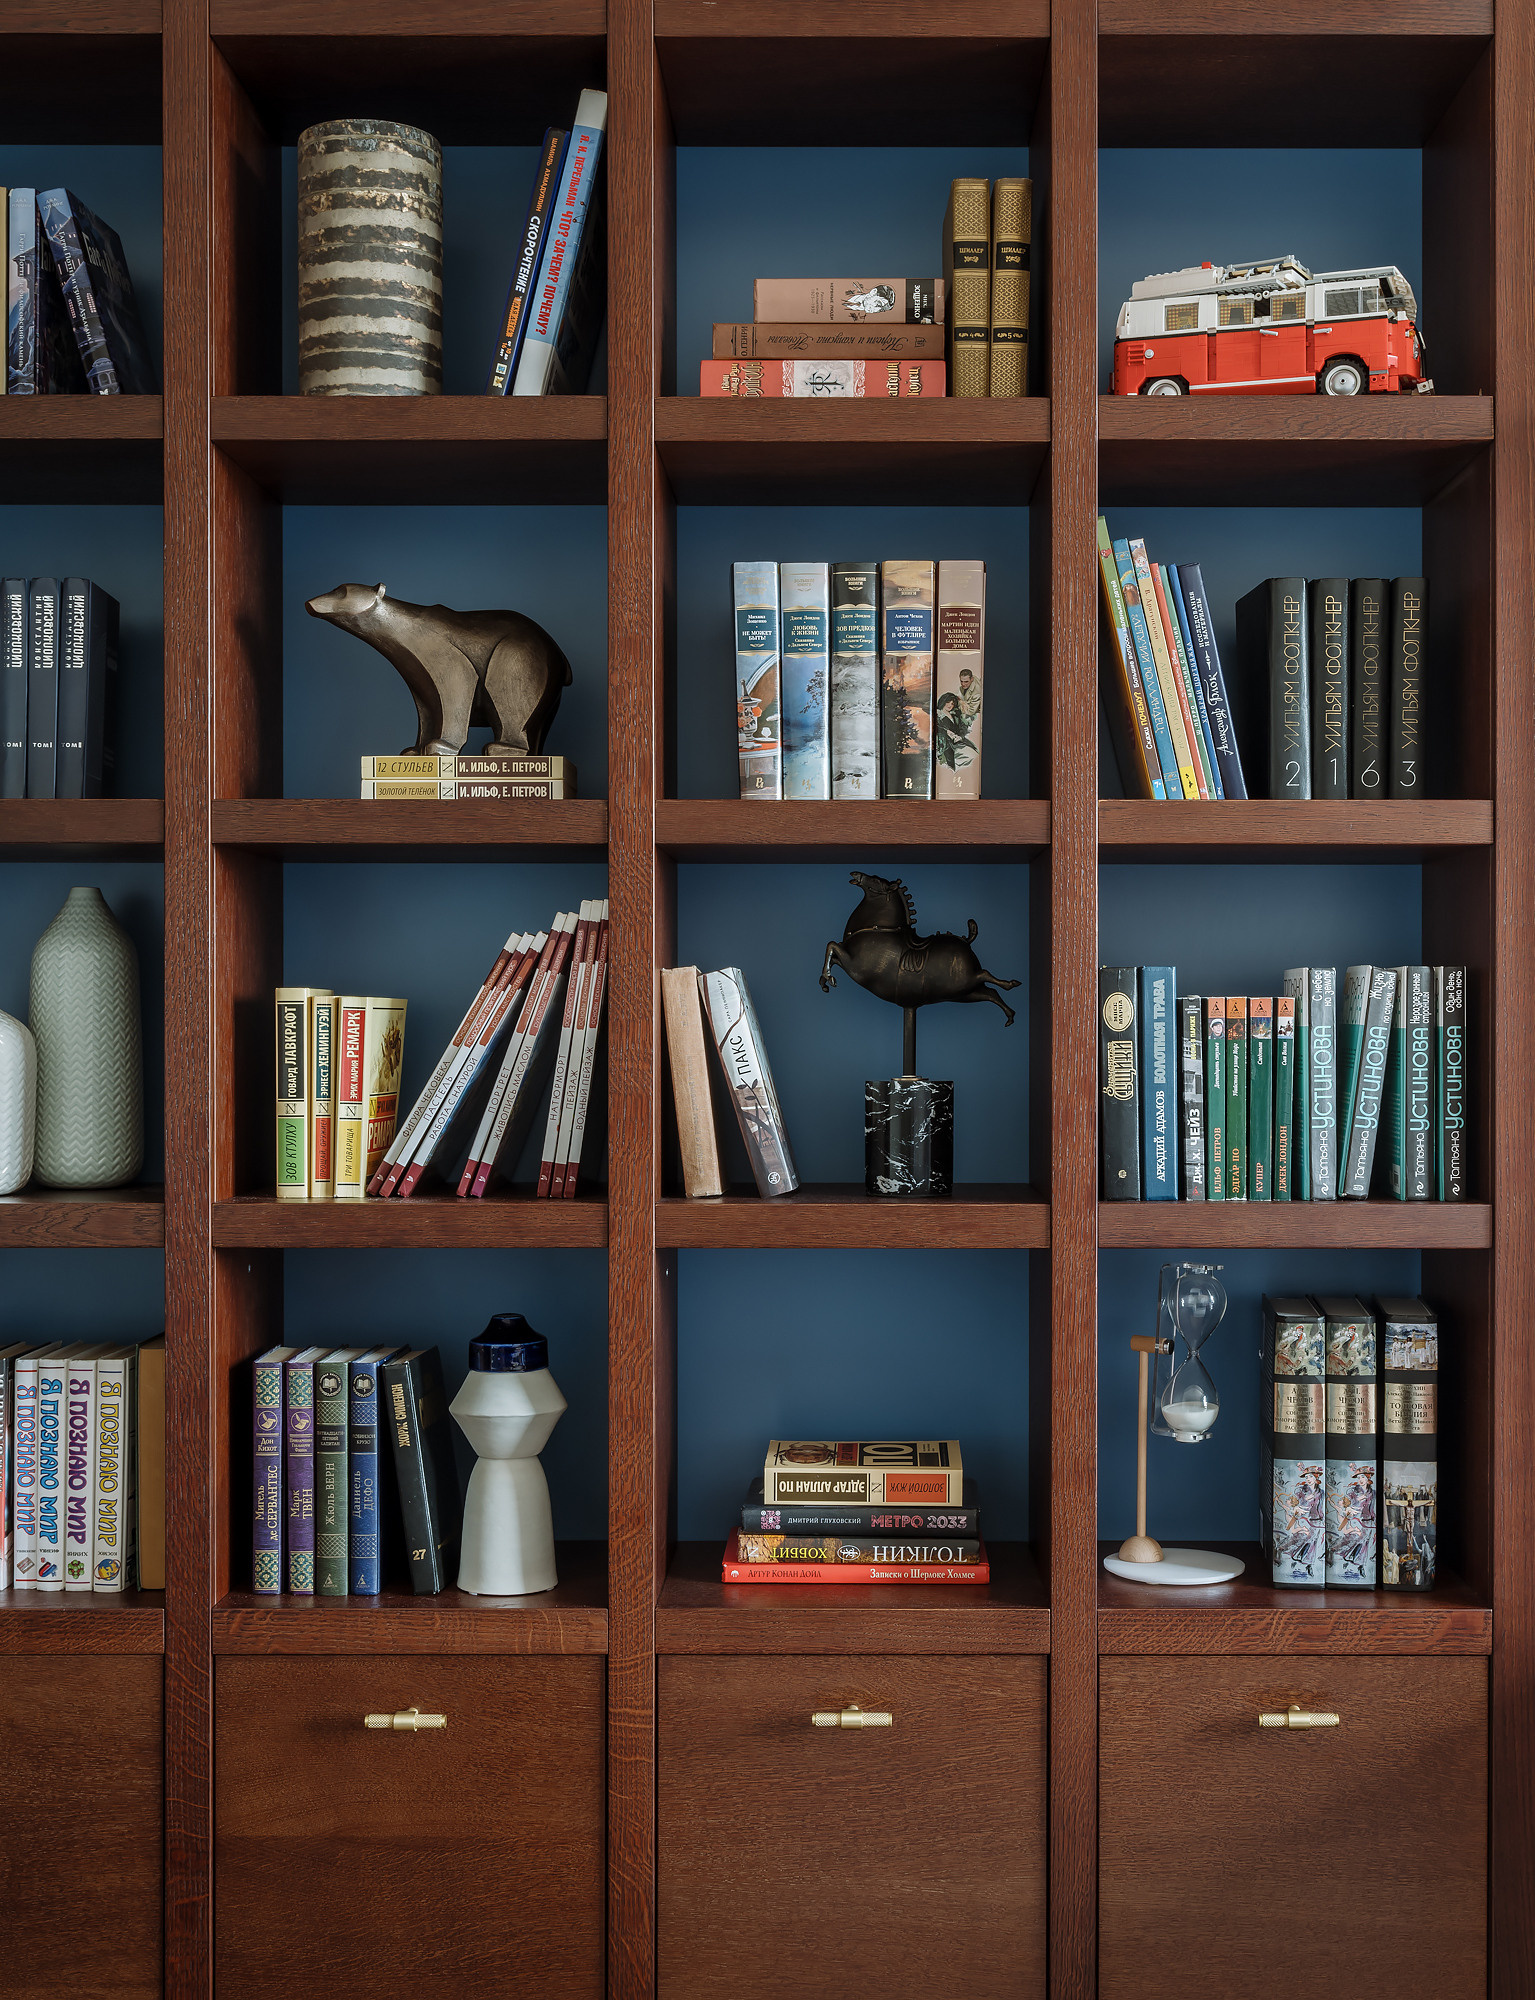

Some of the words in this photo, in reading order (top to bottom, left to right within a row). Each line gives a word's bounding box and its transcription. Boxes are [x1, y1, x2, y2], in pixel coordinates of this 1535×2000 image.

[546, 137, 558, 166] ШАМИЛЬ
[577, 145, 588, 155] И.
[580, 134, 590, 143] Я.
[535, 167, 551, 212] АХМАДУЛЛИН
[565, 156, 585, 206] ПЕРЕЛЬМАН
[560, 211, 574, 237] ЧТО?
[515, 215, 540, 293] СКОРОЧТЕНИЕ
[549, 237, 567, 283] ЗАЧЕМ?
[535, 285, 556, 336] ПОЧЕМУ?
[43, 595, 54, 669] ЦИОЛКОВСКИЙ
[73, 595, 85, 669] ЦИОЛКОВСКИЙ
[1188, 591, 1205, 648] ИССЛЕДОВАНИЯ
[1284, 595, 1300, 675] ФОЛКНЕР
[1325, 595, 1342, 675] ФОЛКНЕР
[1362, 596, 1380, 676] ФОЛКНЕР
[1402, 591, 1421, 672] ФОЛКНЕР
[1186, 641, 1202, 690] ПОРТНЯЖКА
[1195, 690, 1208, 724] ХРАБРЫЙ
[1204, 672, 1223, 706] Блок
[1284, 681, 1300, 752] УИЛЬЯМ
[1325, 681, 1342, 753] УИЛЬЯМ
[1362, 682, 1379, 753] УИЛЬЯМ
[1401, 678, 1419, 749] УИЛЬЯМ
[1216, 708, 1234, 756] Александр
[377, 762, 386, 772] 12
[391, 762, 434, 773] СТУЛЬЕВ
[459, 762, 469, 772] И.
[470, 761, 501, 774] ИЛЬФ,
[502, 762, 511, 772] Е.
[512, 762, 548, 773] ПЕТРОВ
[1285, 761, 1300, 787] 2
[1330, 758, 1337, 786] 1
[1361, 760, 1380, 788] 6
[1399, 760, 1417, 787] 3
[378, 787, 406, 796] ЗОЛОТОЙ
[408, 786, 436, 796] ТЕЛЁНОК
[459, 786, 470, 798] И.
[471, 786, 501, 799] ИЛЬФ,
[502, 786, 511, 798] Е.
[512, 786, 547, 798] ПЕТРОВ
[1410, 972, 1421, 1024] Неразрезанные
[1446, 971, 1456, 992] день,
[1153, 978, 1166, 1024] ТРАВА
[1445, 993, 1455, 1013] Один
[284, 1006, 298, 1066] ЛАВКРАФТ
[317, 1008, 330, 1065] ХЕМИНГУЭЙ
[346, 1012, 361, 1058] РЕМАРК
[351, 1060, 359, 1082] МАРИЯ
[581, 1046, 594, 1087] ПЕЙЗАЖ
[729, 1035, 752, 1076] ПАКС
[1153, 1026, 1166, 1084] БОЛОТНАЯ
[287, 1067, 298, 1098] ГОВАРД
[321, 1066, 329, 1097] ЭРНЕСТ
[350, 1083, 358, 1100] ЭРИХ
[487, 1067, 511, 1114] ПОРТРЕТ
[492, 1089, 516, 1141] ЖИВОПИСЬ
[511, 1046, 533, 1090] МАСЛОМ
[549, 1054, 567, 1121] НАТЮРМОРТ
[565, 1069, 579, 1110] ПЕЙЗАЖ
[1311, 1025, 1336, 1130] УСТИНОВА
[1354, 1026, 1388, 1130] УСТИНОВА
[1410, 1027, 1430, 1131] УСТИНОВА
[1445, 1025, 1465, 1129] УСТИНОВА
[402, 1101, 424, 1139] ФИГУРА
[419, 1060, 451, 1103] ЧЕЛОВЕКА
[423, 1076, 453, 1122] ПАСТЕЛЬ
[575, 1087, 589, 1131] ВОДНЫЙ
[1155, 1090, 1165, 1135] АДАМОВ
[286, 1122, 297, 1157] КТУЛХУ
[345, 1128, 354, 1162] ТОВАРИЩА
[368, 1120, 396, 1150] РЕМАРК
[1186, 1108, 1201, 1147] ЧЕЙЗ
[1213, 1127, 1222, 1163] ПЕТРОВ
[1279, 1125, 1288, 1162] ЛОНДОН
[286, 1159, 297, 1180] ЗОВ
[344, 1164, 353, 1177] ТРИ
[1156, 1137, 1166, 1183] АРКАДИЙ
[1192, 1148, 1201, 1161] Х.
[1231, 1147, 1240, 1163] ПО
[1319, 1130, 1329, 1181] Татьяна
[1354, 1130, 1370, 1180] Татьяна
[1415, 1132, 1425, 1178] Татьяна
[1450, 1130, 1461, 1182] Татьяна
[1192, 1163, 1203, 1184] Дж.
[1214, 1166, 1222, 1194] ИЛЬФ
[1232, 1165, 1241, 1194] ЭДГАР
[1255, 1162, 1264, 1192] КУПЕР
[1279, 1163, 1287, 1193] ДЖЕК
[16, 1384, 38, 1400] Я
[40, 1378, 63, 1396] Я
[69, 1378, 91, 1396] Я
[100, 1380, 122, 1398] Я
[391, 1383, 407, 1420] СИМЕНОН
[16, 1404, 36, 1488] ПОЗНАЮ
[39, 1399, 59, 1490] ПОЗНАЮ
[68, 1400, 88, 1491] ПОЗНАЮ
[99, 1402, 120, 1494] ПОЗНАЮ
[257, 1444, 277, 1453] Кихот
[398, 1421, 409, 1447] ЖОРЖ
[325, 1462, 335, 1490] ВЕРН
[779, 1481, 794, 1493] ПО
[795, 1481, 832, 1493] АЛЛАН
[832, 1480, 866, 1493] ЭДГАР
[889, 1482, 908, 1493] ЖУК
[908, 1481, 945, 1495] ЗОЛОТОЙ
[255, 1485, 265, 1520] Мигель
[267, 1465, 278, 1529] СЕРВАНТЕС
[290, 1489, 301, 1518] Марк
[302, 1488, 313, 1519] ТВЕН
[324, 1491, 336, 1526] Жюль
[352, 1470, 363, 1519] Даниель
[363, 1478, 375, 1511] ДЕФО
[16, 1492, 36, 1536] МИР
[39, 1496, 58, 1545] МИР
[67, 1496, 87, 1545] МИР
[97, 1498, 118, 1547] МИР
[870, 1514, 924, 1528] МЕТРО
[926, 1515, 968, 1528] 2033
[269, 1530, 278, 1541] де
[769, 1547, 828, 1559] ХОББИТ
[412, 1549, 427, 1561] 27
[872, 1545, 968, 1563] ТОЛКИН
[870, 1568, 902, 1579] Записки
[910, 1569, 946, 1580] Шерлоке
[947, 1569, 976, 1580] Холмсе
